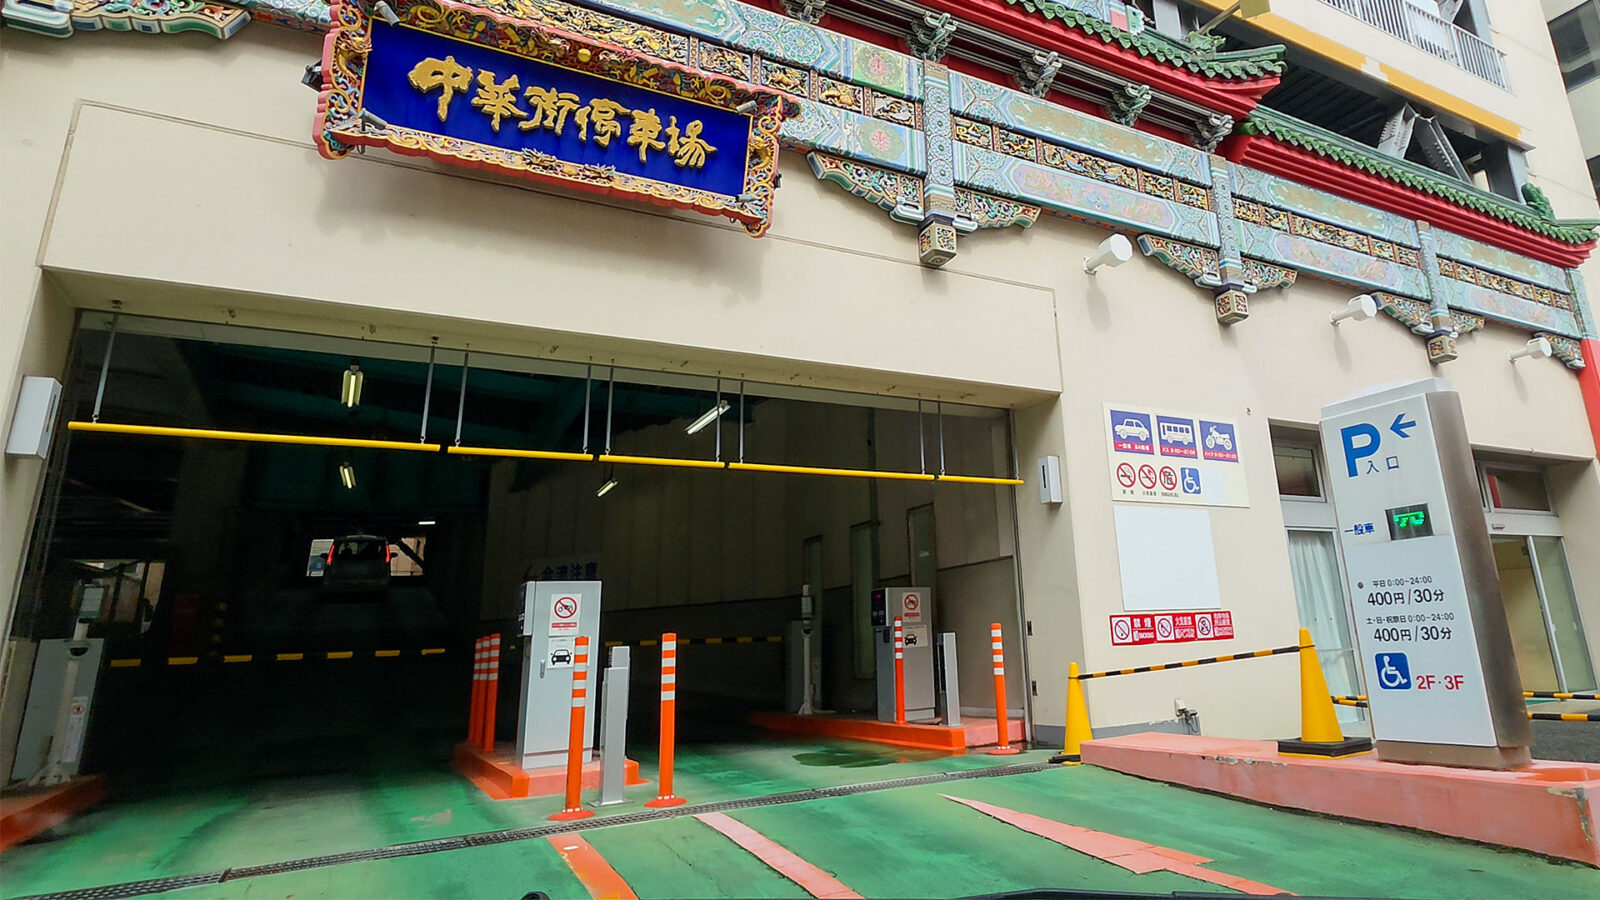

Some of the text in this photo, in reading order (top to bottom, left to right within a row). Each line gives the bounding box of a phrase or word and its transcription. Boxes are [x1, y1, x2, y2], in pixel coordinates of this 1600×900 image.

[407, 55, 717, 168] 中華街停車場
[1340, 423, 1381, 477] P
[1366, 456, 1400, 475] 入口
[1344, 523, 1375, 535] 一般車
